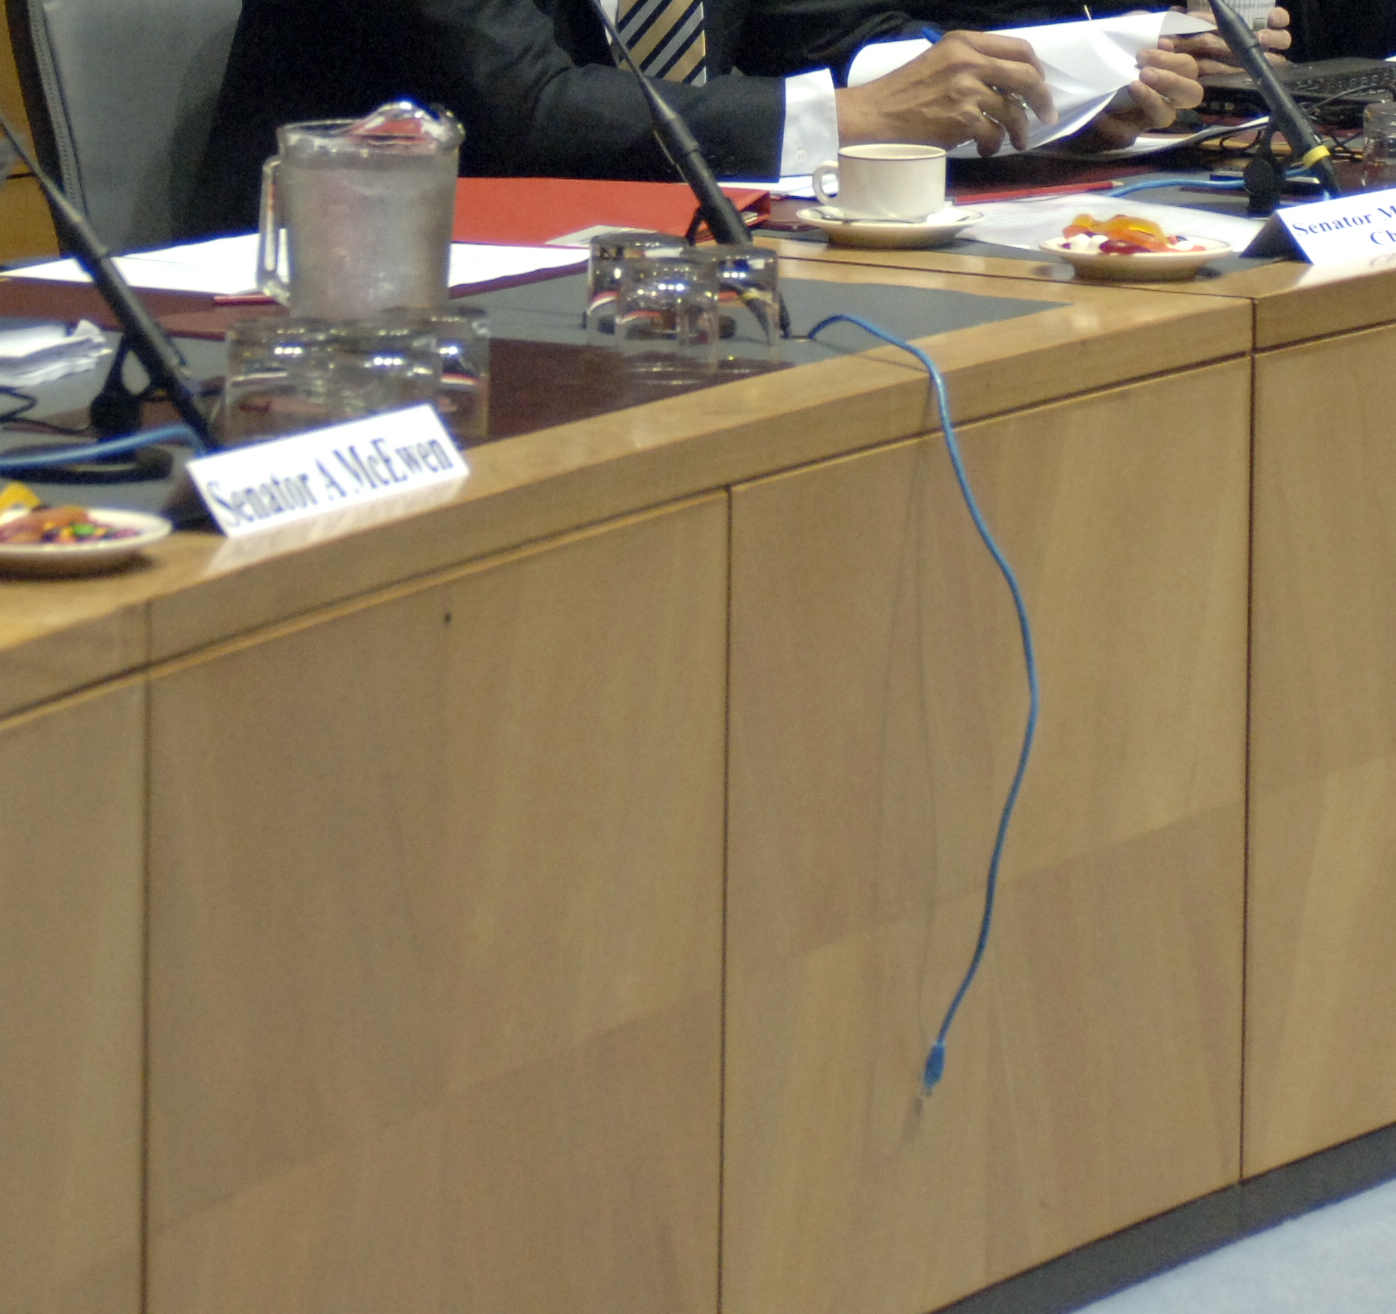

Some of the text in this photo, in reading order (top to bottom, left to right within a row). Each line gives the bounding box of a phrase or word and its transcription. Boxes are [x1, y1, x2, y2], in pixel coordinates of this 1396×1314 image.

[1292, 212, 1372, 237] Senator
[206, 437, 453, 527] Senator A McEwen
